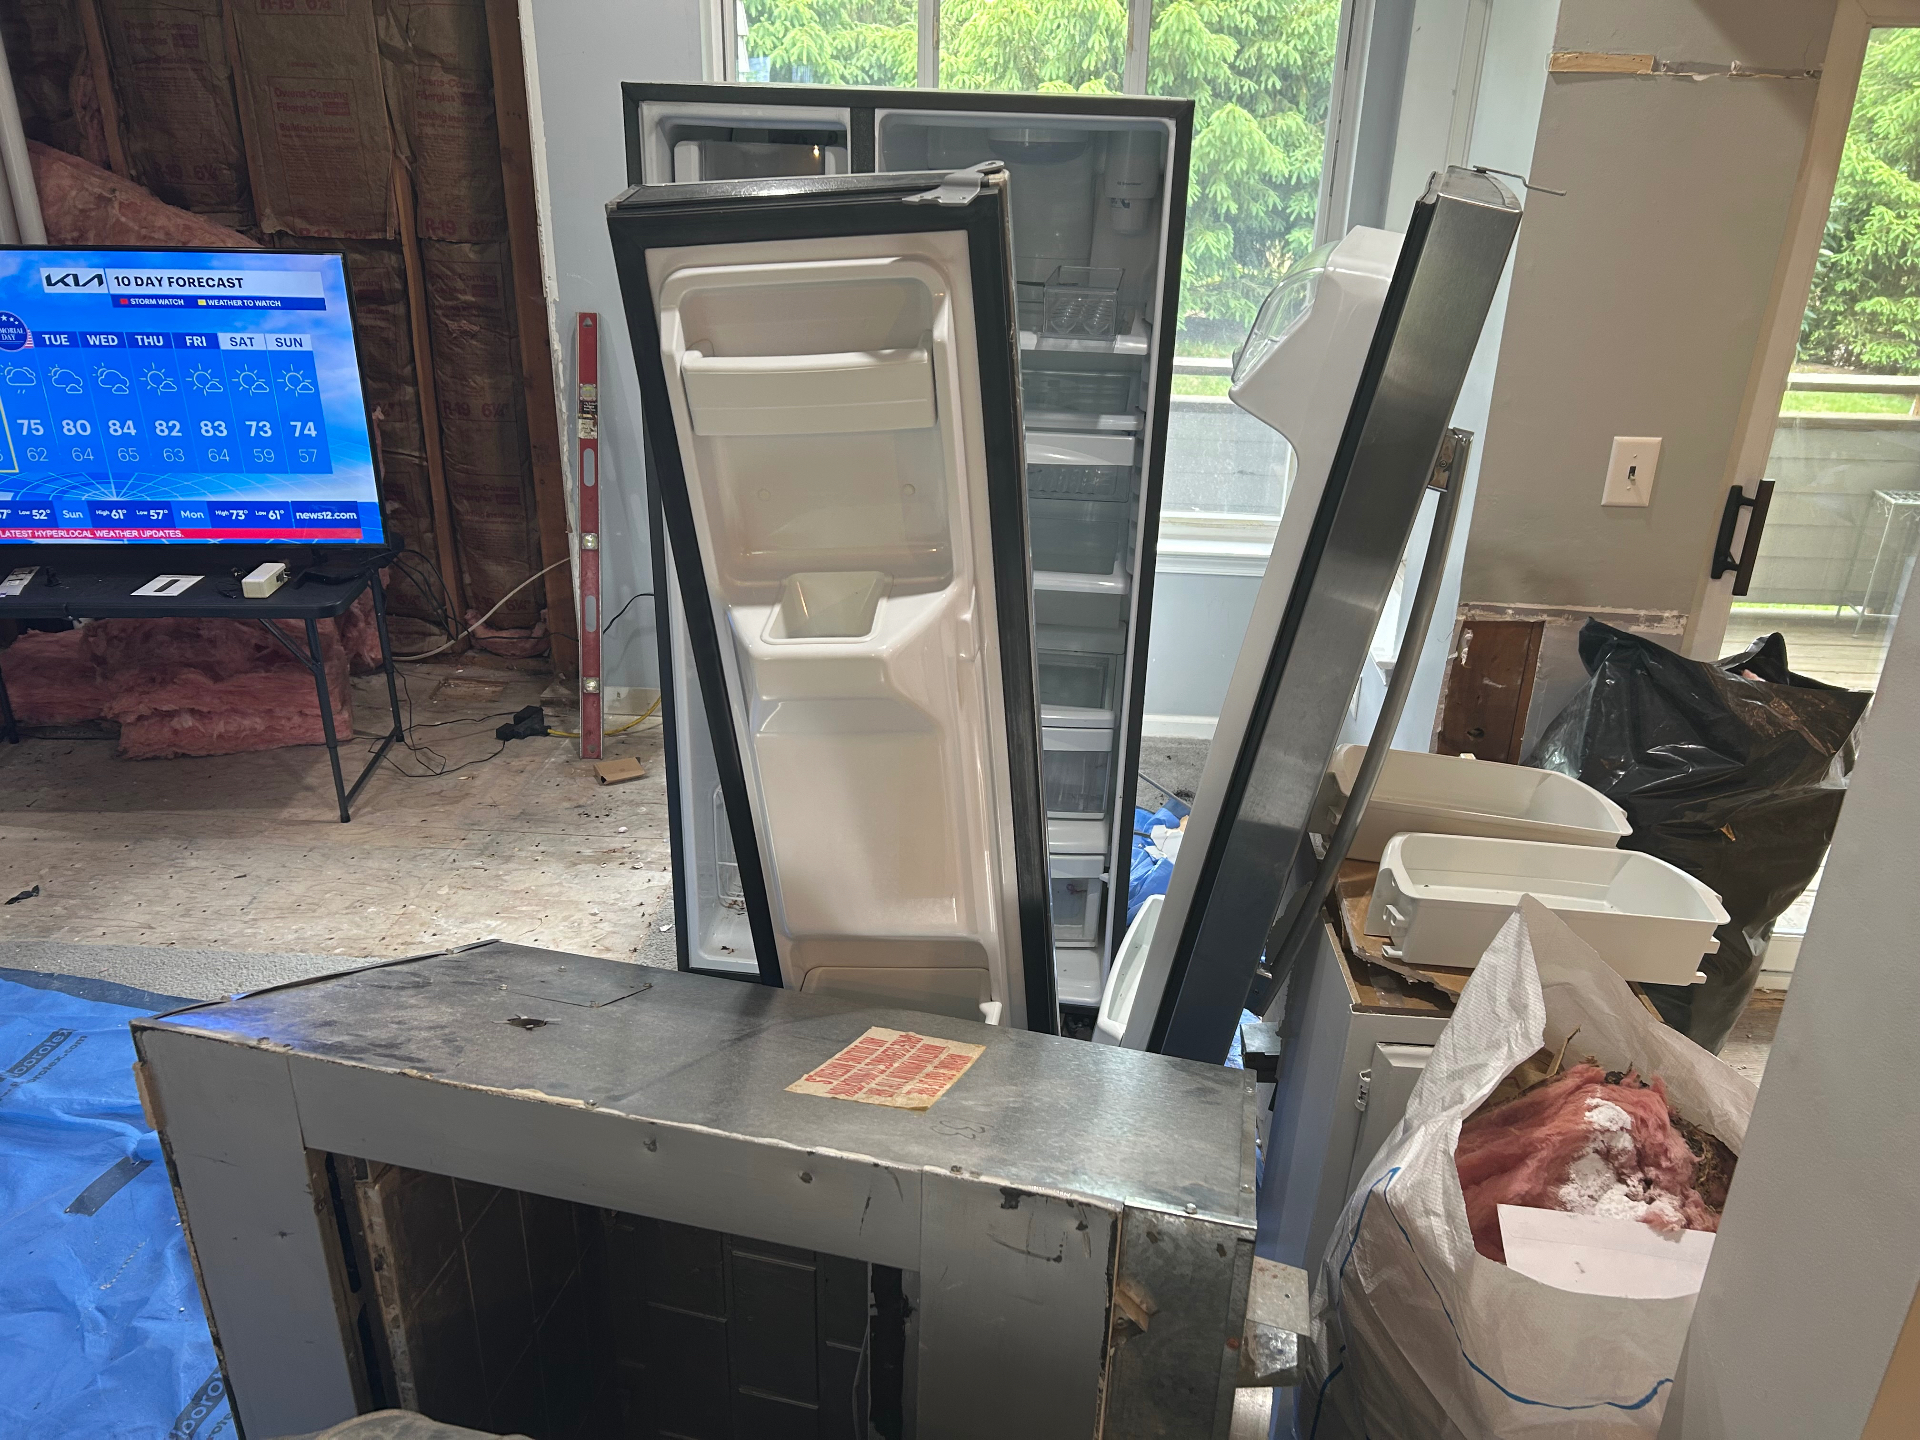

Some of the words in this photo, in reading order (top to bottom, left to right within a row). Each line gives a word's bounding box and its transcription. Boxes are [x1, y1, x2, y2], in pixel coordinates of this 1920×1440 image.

[274, 87, 348, 101] Owens-Corning
[280, 123, 312, 133] Building
[425, 217, 456, 236] R-19
[114, 276, 131, 287] 10
[134, 277, 163, 287] DAY
[168, 277, 243, 289] FORECAST
[130, 298, 157, 306] STORM
[158, 298, 184, 306] WATCH
[207, 299, 243, 307] WEATHER
[1, 333, 16, 341] DAY
[42, 334, 70, 346] TUE
[87, 335, 118, 346] WED
[135, 335, 164, 346] THU
[185, 335, 207, 347] FRI
[229, 336, 255, 347] SAT
[275, 337, 303, 348] SUN
[442, 400, 471, 419] R-19
[16, 419, 44, 436] 75
[61, 419, 91, 436] 80
[108, 419, 137, 436] 84
[154, 420, 183, 437] 82
[200, 420, 228, 437] 83
[245, 421, 272, 437] 73
[289, 421, 318, 437] 74
[26, 447, 49, 462] 62
[71, 447, 94, 462] 64
[117, 447, 140, 462] 65
[163, 448, 185, 462] 63
[208, 448, 230, 462] 64
[253, 448, 275, 463] 59
[298, 449, 317, 463] 57
[32, 509, 50, 520] 52°
[63, 509, 83, 519] Sun
[111, 509, 127, 520] 61°
[150, 509, 168, 520] 57°
[180, 510, 204, 519] Mon
[230, 509, 249, 520] 73°
[268, 509, 285, 520] 61°
[296, 510, 357, 520] news12.com
[0, 530, 33, 538] LATEST
[35, 530, 94, 538] HYPERLOCAL
[95, 530, 139, 538] WEATHER
[141, 530, 184, 538] UPDATES.
